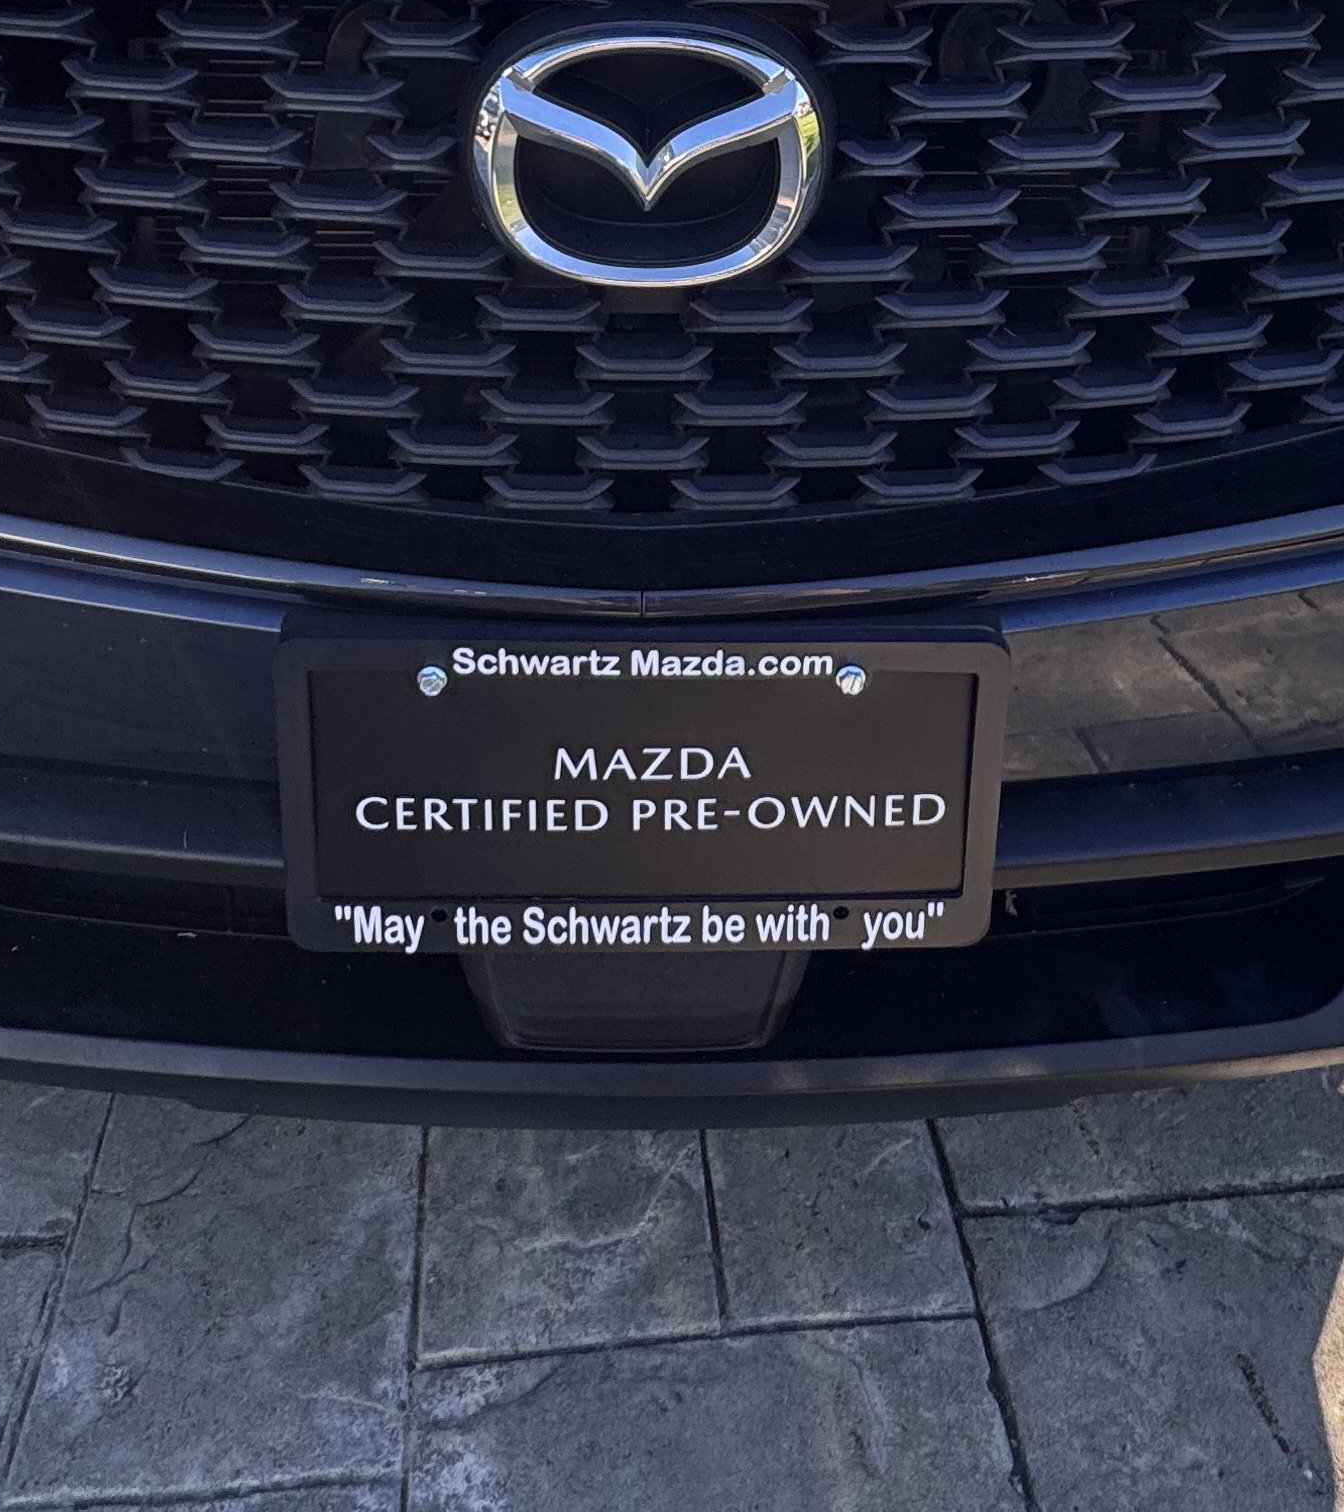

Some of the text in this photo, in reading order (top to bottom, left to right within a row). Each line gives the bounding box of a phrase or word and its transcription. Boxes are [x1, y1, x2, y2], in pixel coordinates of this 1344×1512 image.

[452, 647, 834, 678] Schwartz Mazda.com
[553, 747, 752, 781] MAZDA
[355, 792, 947, 832] CERTIFIED PRE-OWNED
[334, 901, 946, 954] "May the Schwartz be with you"
